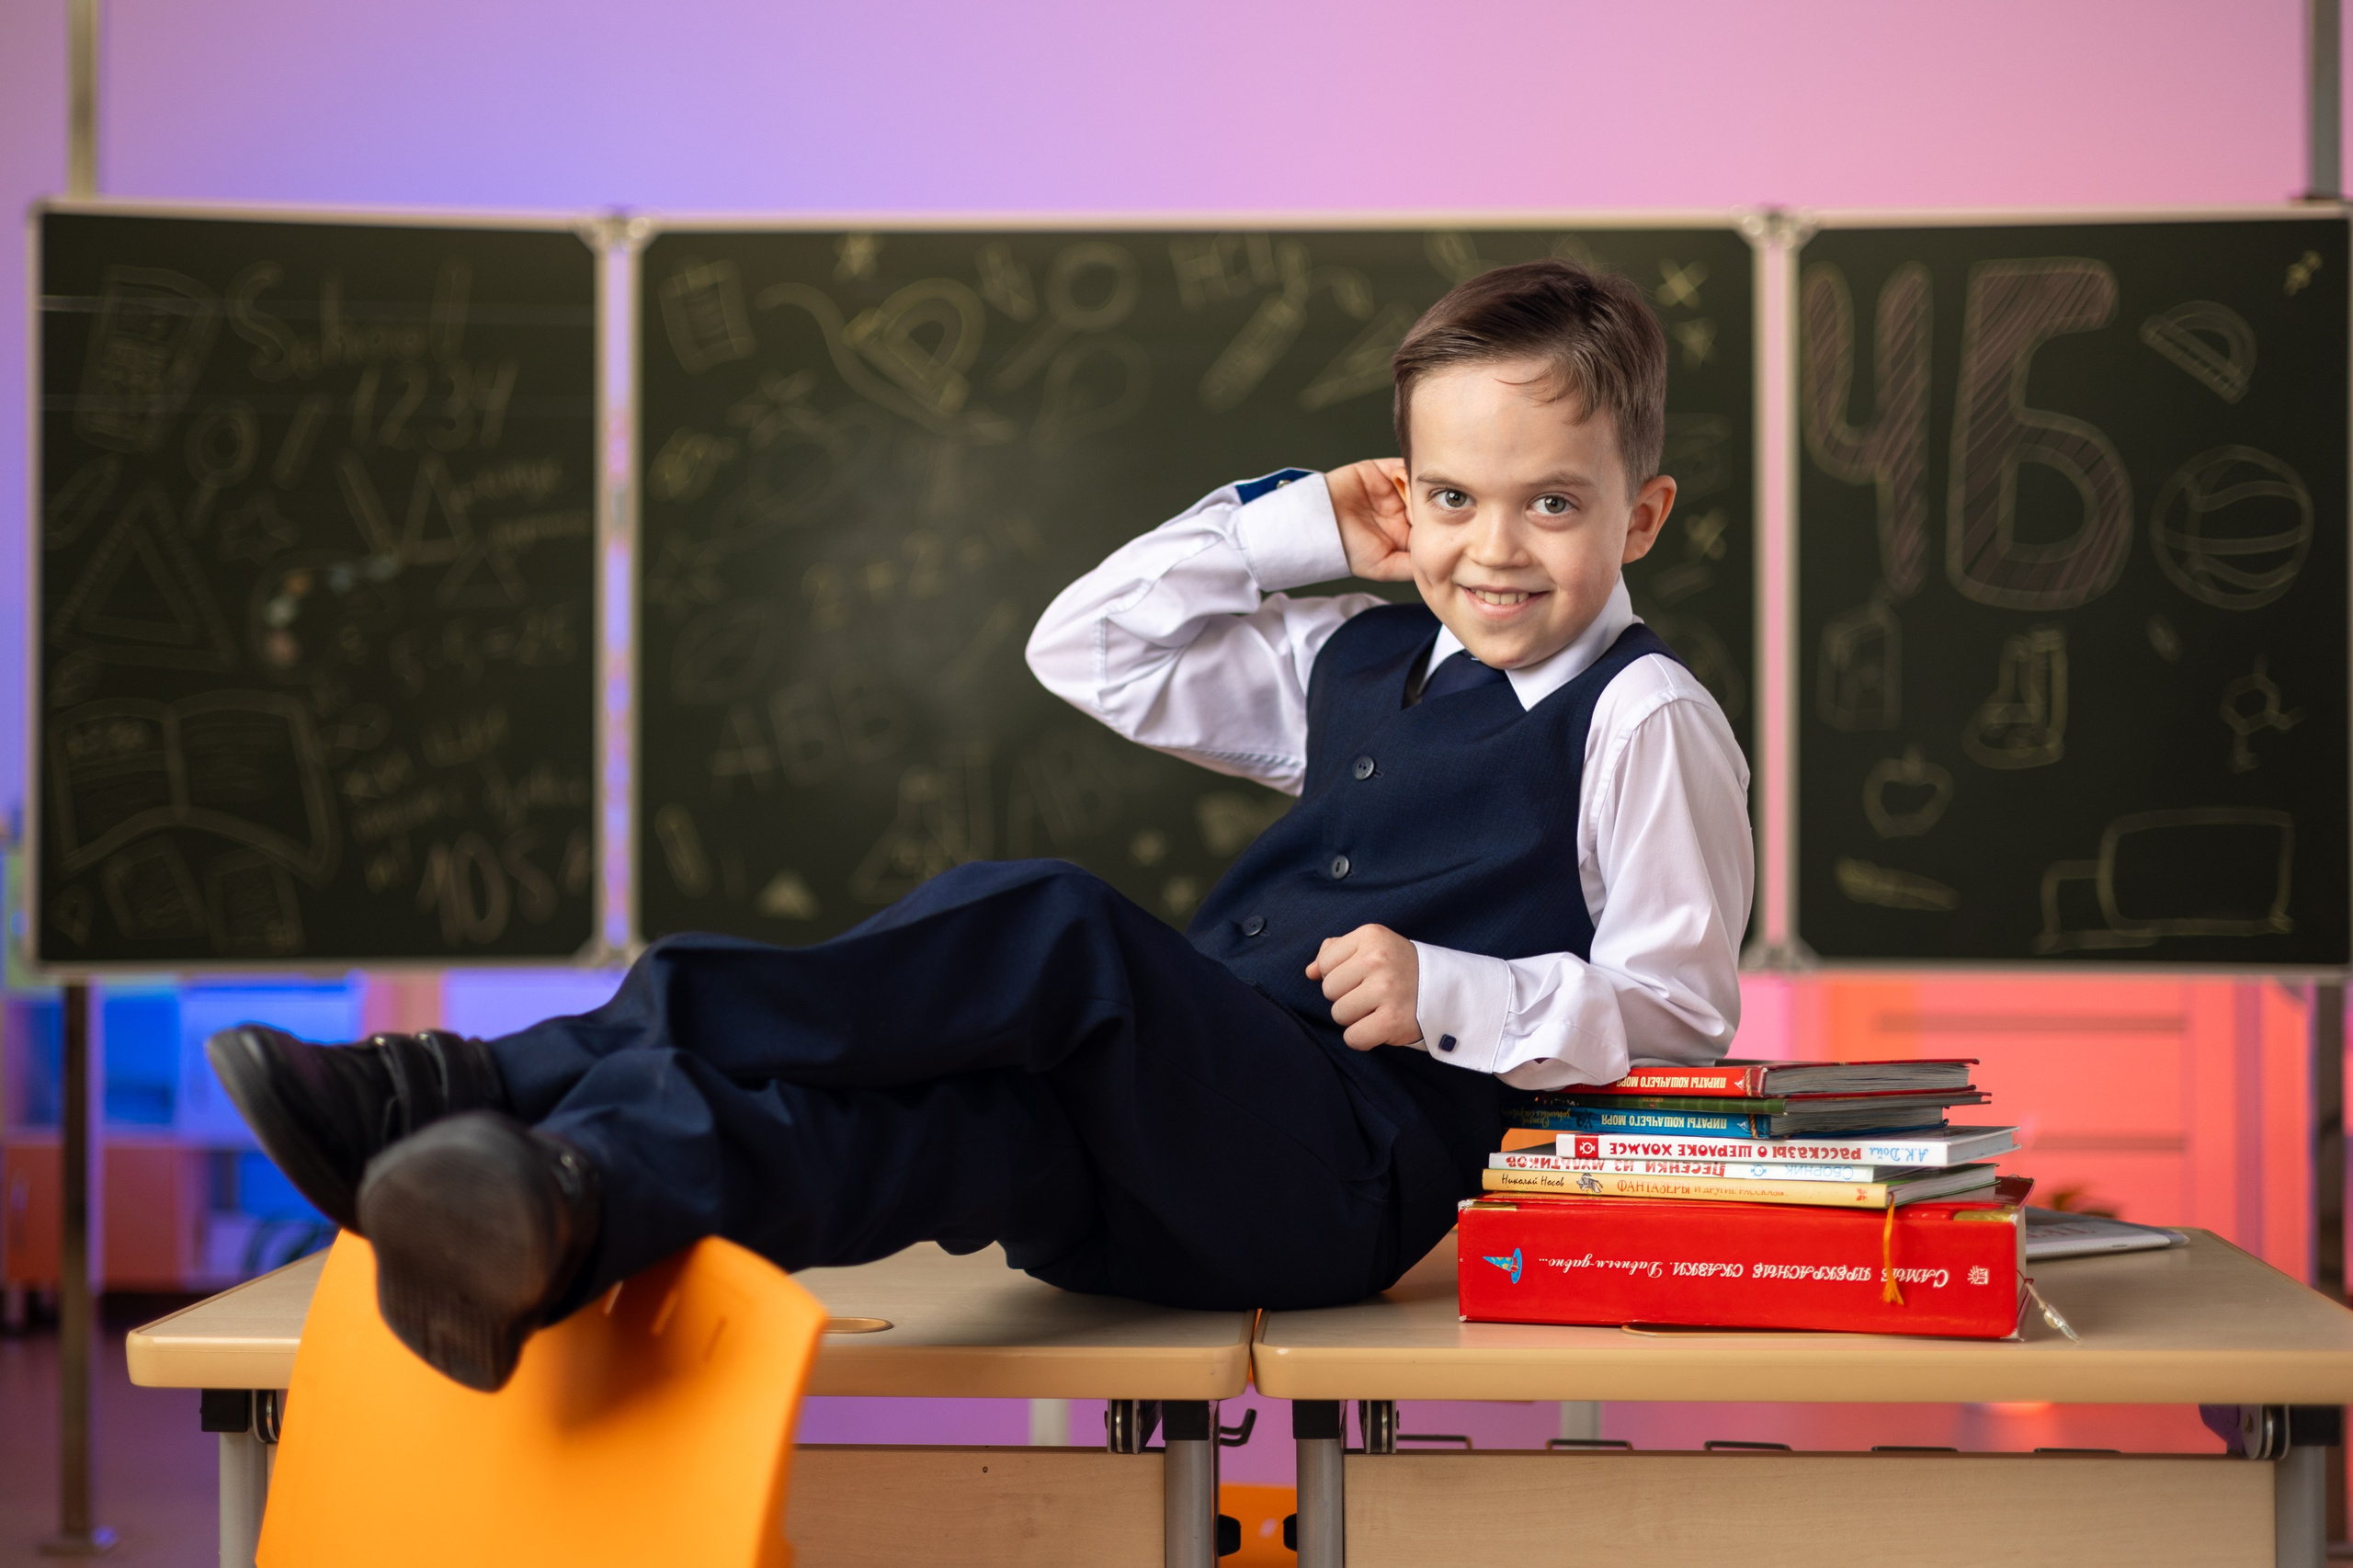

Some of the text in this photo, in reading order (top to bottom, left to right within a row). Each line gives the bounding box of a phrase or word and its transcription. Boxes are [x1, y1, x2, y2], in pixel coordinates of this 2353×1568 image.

[1640, 1076, 1689, 1088] КОШАЧЬЕГО
[1691, 1076, 1727, 1089] ПИРАТЫ
[1601, 1115, 1728, 1130] ПИРАТЫ КОШАЧЬЕГО МОРЯ
[1609, 1142, 1673, 1157] ХОЛМСЕ
[1677, 1144, 1753, 1158] ШЕРЛОКЕ
[1506, 1156, 1726, 1177] ПЕСЕНКИ ИЗ МУЛЬТИКОВ
[1501, 1173, 1564, 1187] Николай Носов
